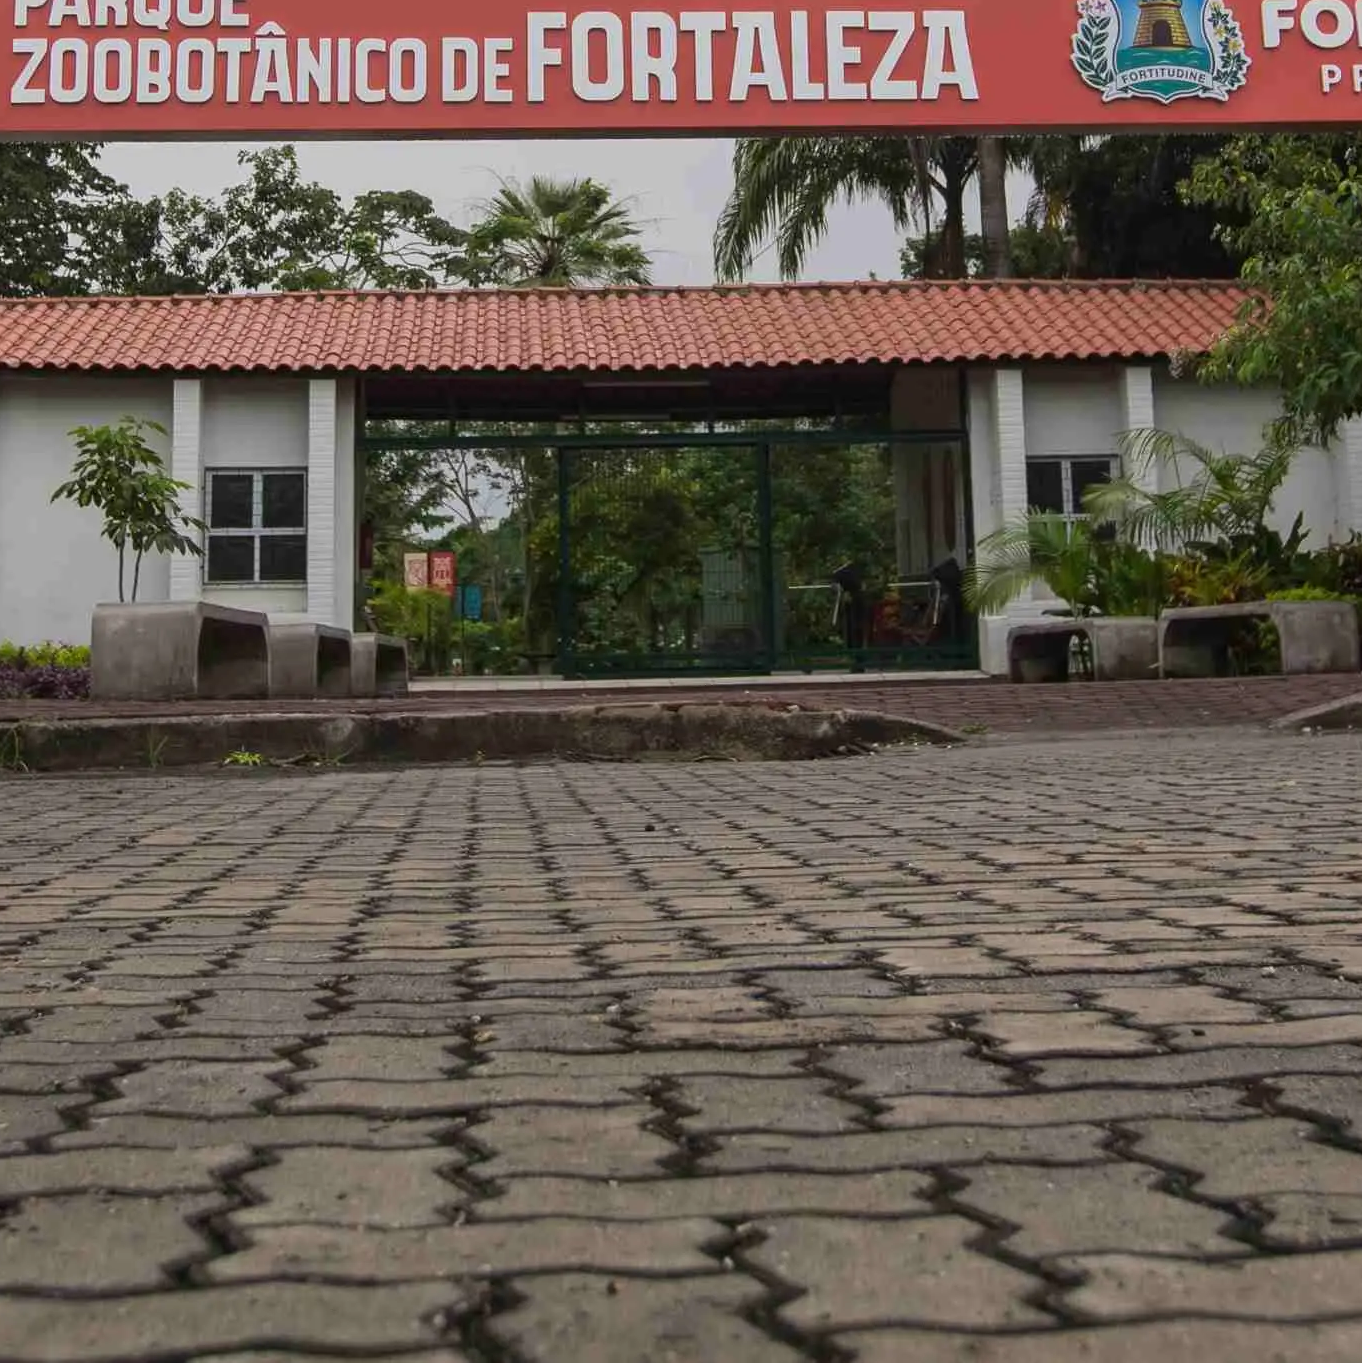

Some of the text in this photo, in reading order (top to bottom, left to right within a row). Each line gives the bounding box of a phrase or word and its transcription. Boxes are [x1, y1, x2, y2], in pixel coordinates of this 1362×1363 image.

[10, 10, 980, 104] ZOOBOTÂNICO DE FORTALEZA
[1121, 68, 1206, 84] FORTITUDINE
